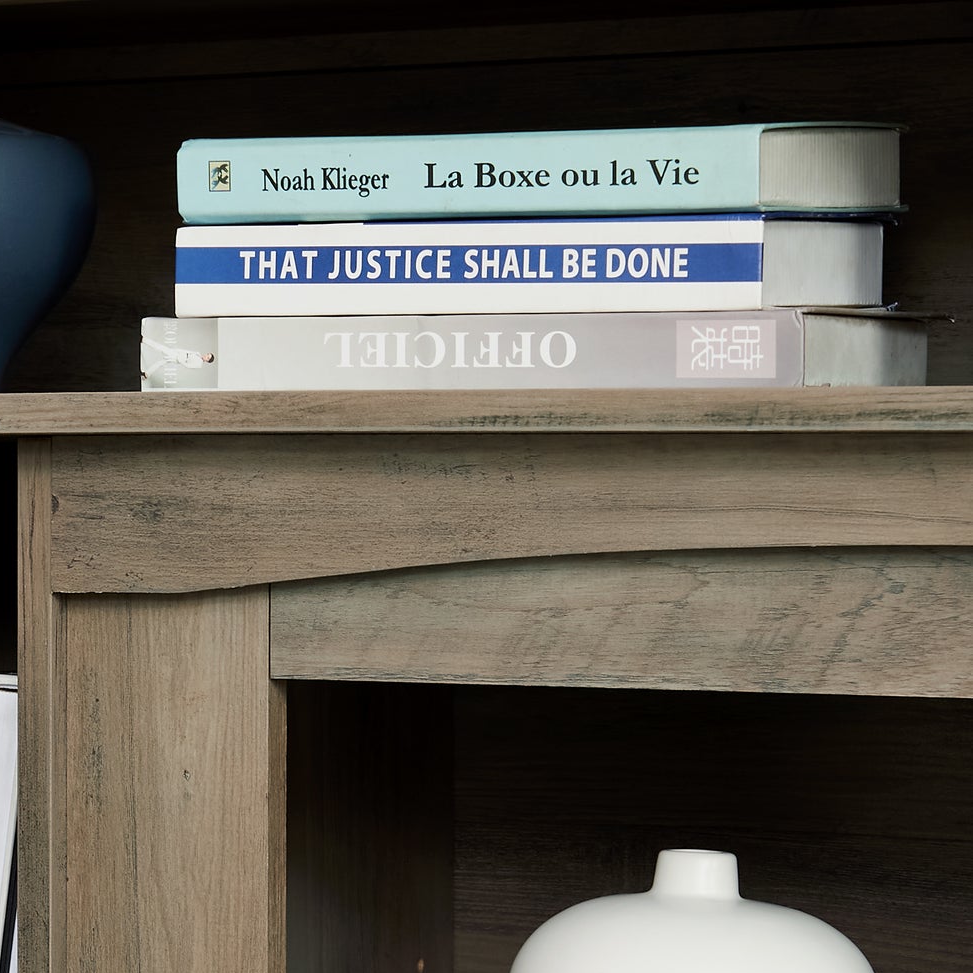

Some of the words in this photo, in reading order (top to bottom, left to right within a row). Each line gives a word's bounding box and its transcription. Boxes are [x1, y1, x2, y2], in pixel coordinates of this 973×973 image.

[260, 168, 315, 191] Noah
[321, 167, 390, 197] Klieger
[423, 162, 464, 188] La
[473, 162, 551, 188] Boxe
[561, 168, 600, 187] ou
[609, 160, 637, 186] la
[646, 158, 700, 185] Vie
[239, 250, 318, 280] THAT
[328, 249, 451, 280] JUSTICE
[463, 248, 554, 280] SHALL
[562, 248, 597, 279] BE
[605, 247, 689, 279] DONE
[323, 330, 577, 369] OFFICIEL
